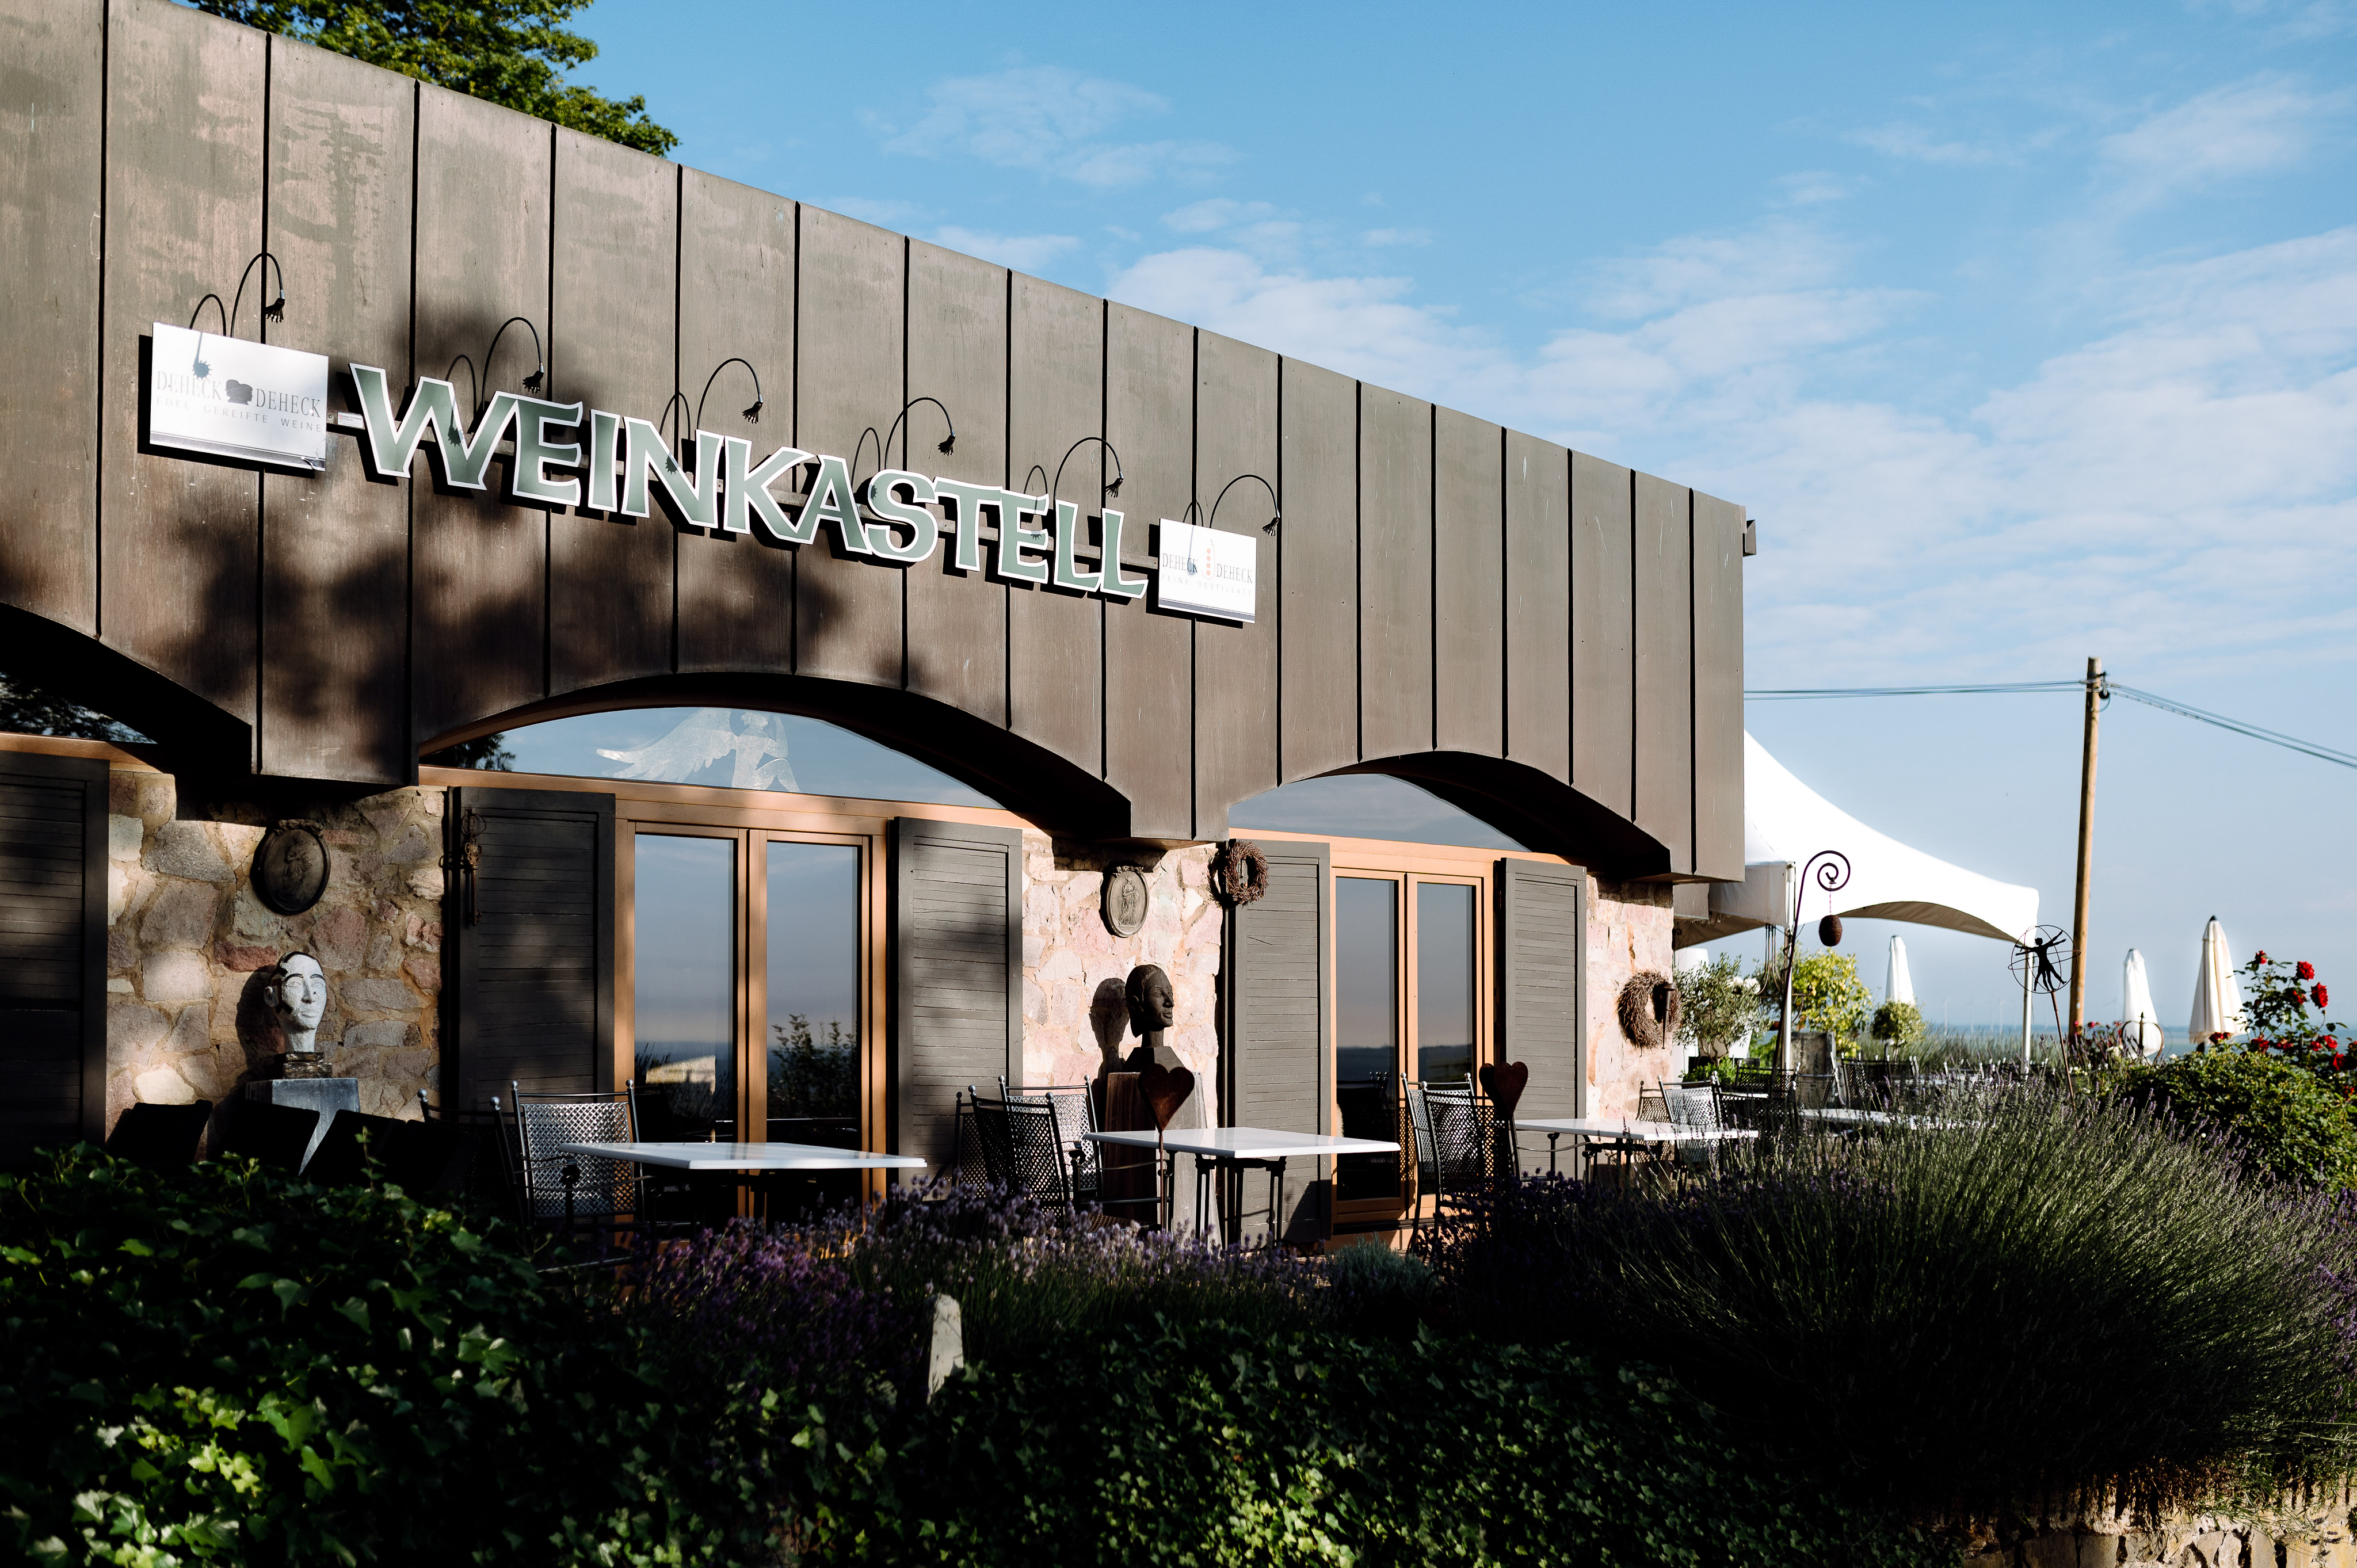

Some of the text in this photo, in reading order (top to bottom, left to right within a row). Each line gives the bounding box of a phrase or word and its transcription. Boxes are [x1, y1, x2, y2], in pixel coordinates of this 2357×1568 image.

[157, 371, 321, 418] DEHECK DEHECK
[204, 405, 268, 423] GEREIFTE
[281, 418, 322, 432] WEINE
[349, 363, 1148, 599] WEINKASTELL
[1162, 553, 1252, 583] DEHECK DEHECK
[1162, 574, 1251, 596] FEINE DESTILLATE
